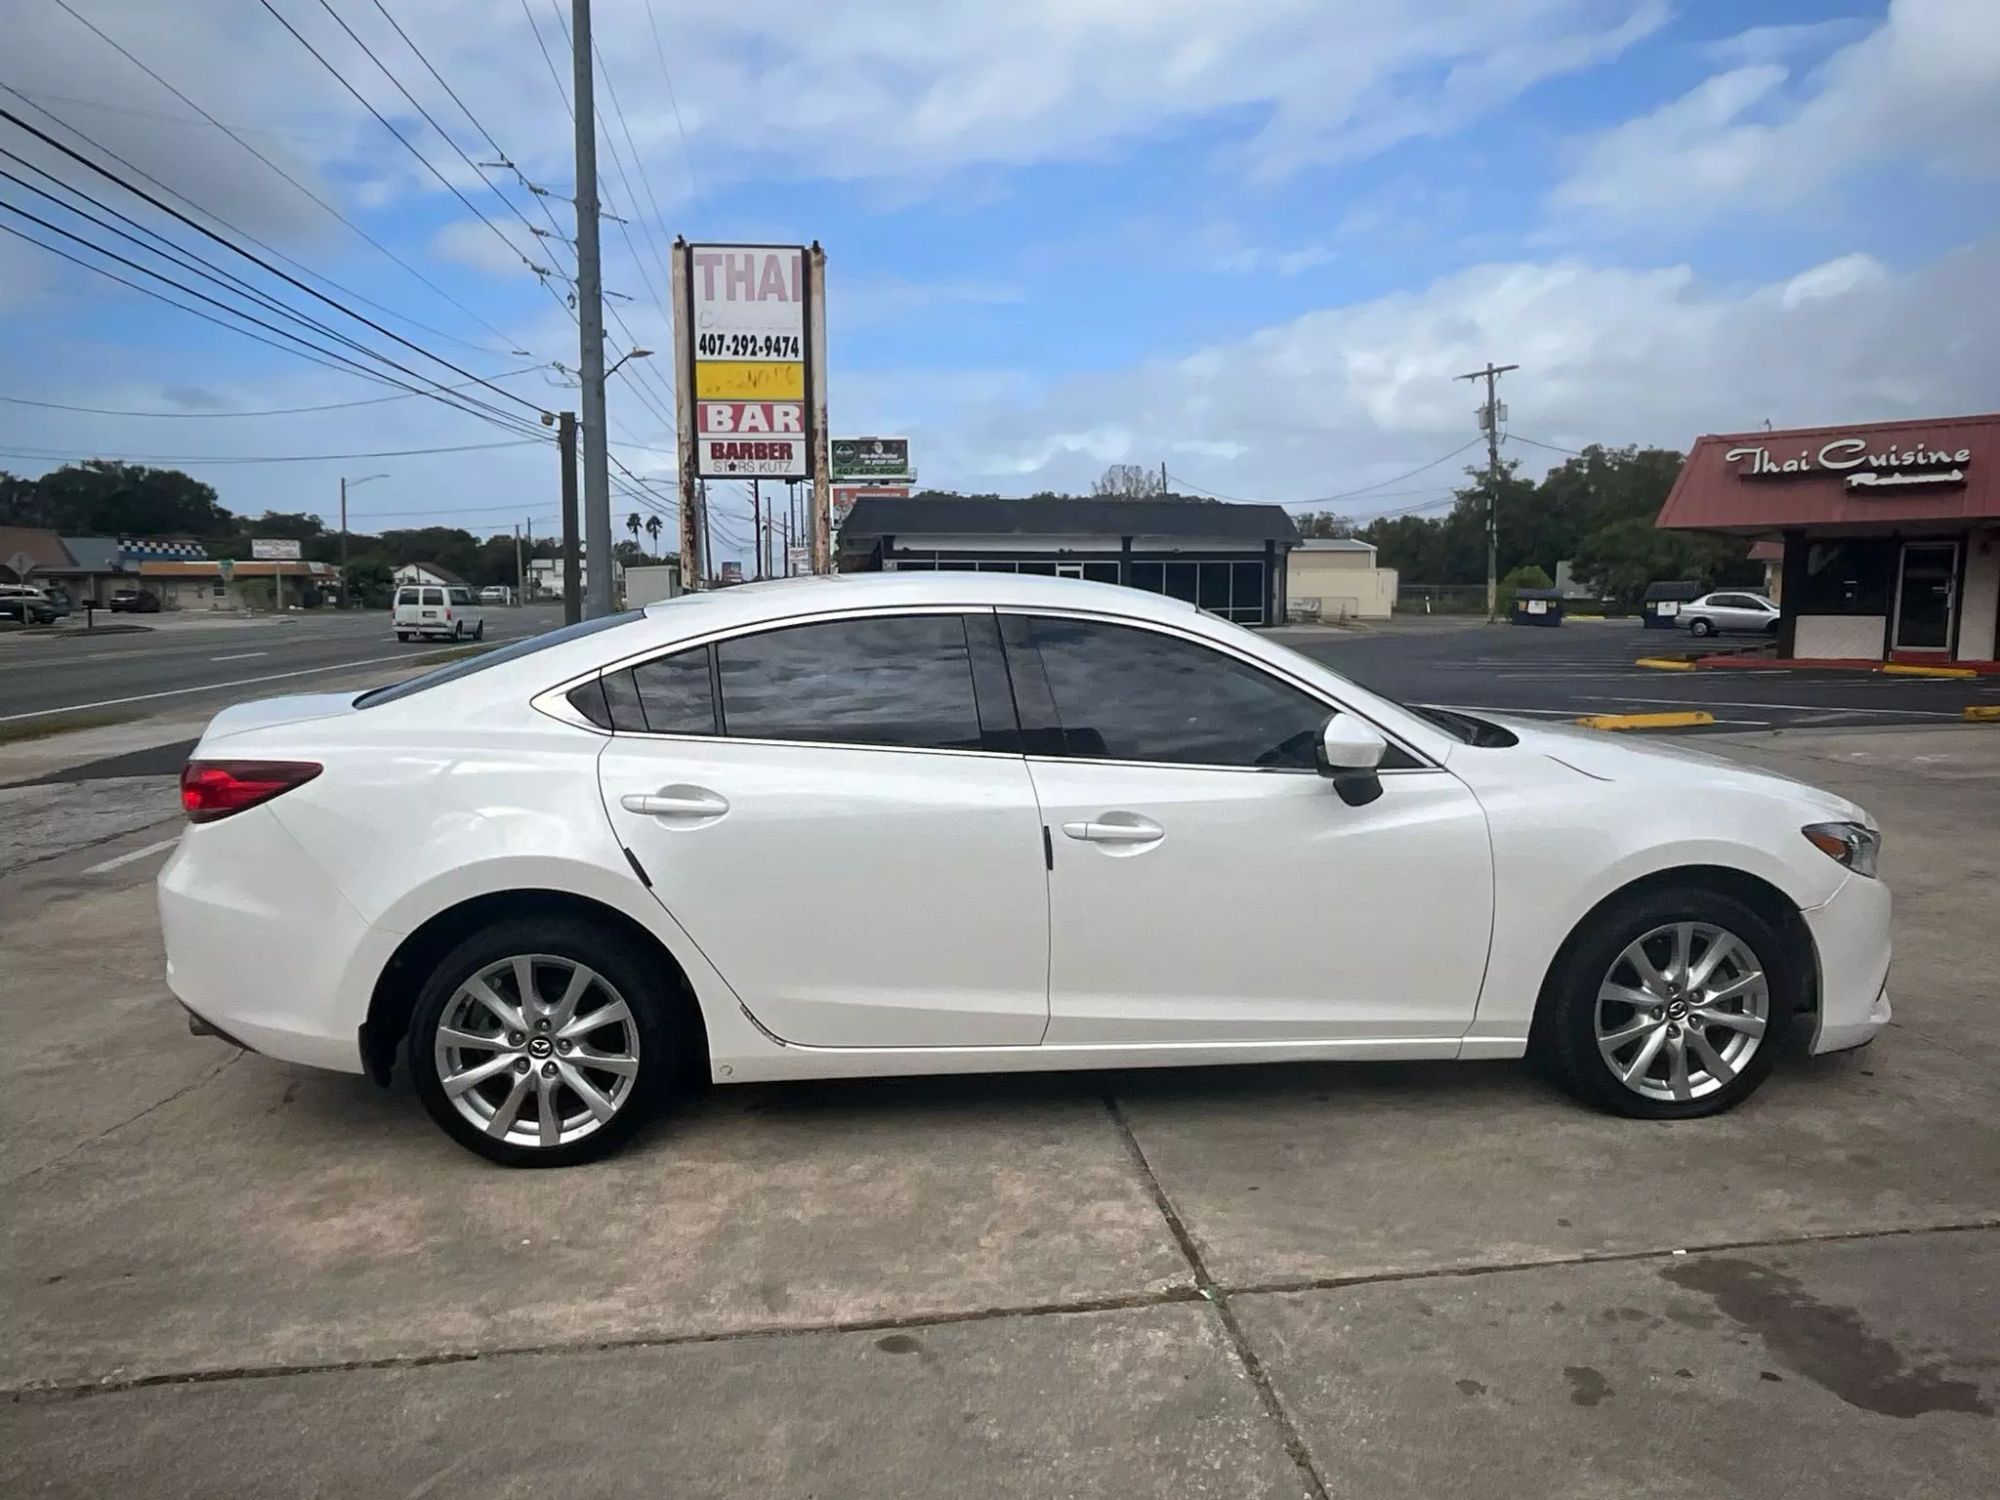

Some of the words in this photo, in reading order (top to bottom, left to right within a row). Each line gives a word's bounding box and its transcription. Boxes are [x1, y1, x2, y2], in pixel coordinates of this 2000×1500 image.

[695, 253, 801, 302] THAI
[699, 333, 799, 358] 407-292-9474
[707, 405, 801, 431] BAR
[711, 442, 793, 460] BARBER
[1725, 446, 1810, 474] Thai
[1818, 438, 1970, 470] Cuisine
[713, 461, 755, 473] STRS
[759, 461, 792, 473] KUTZ
